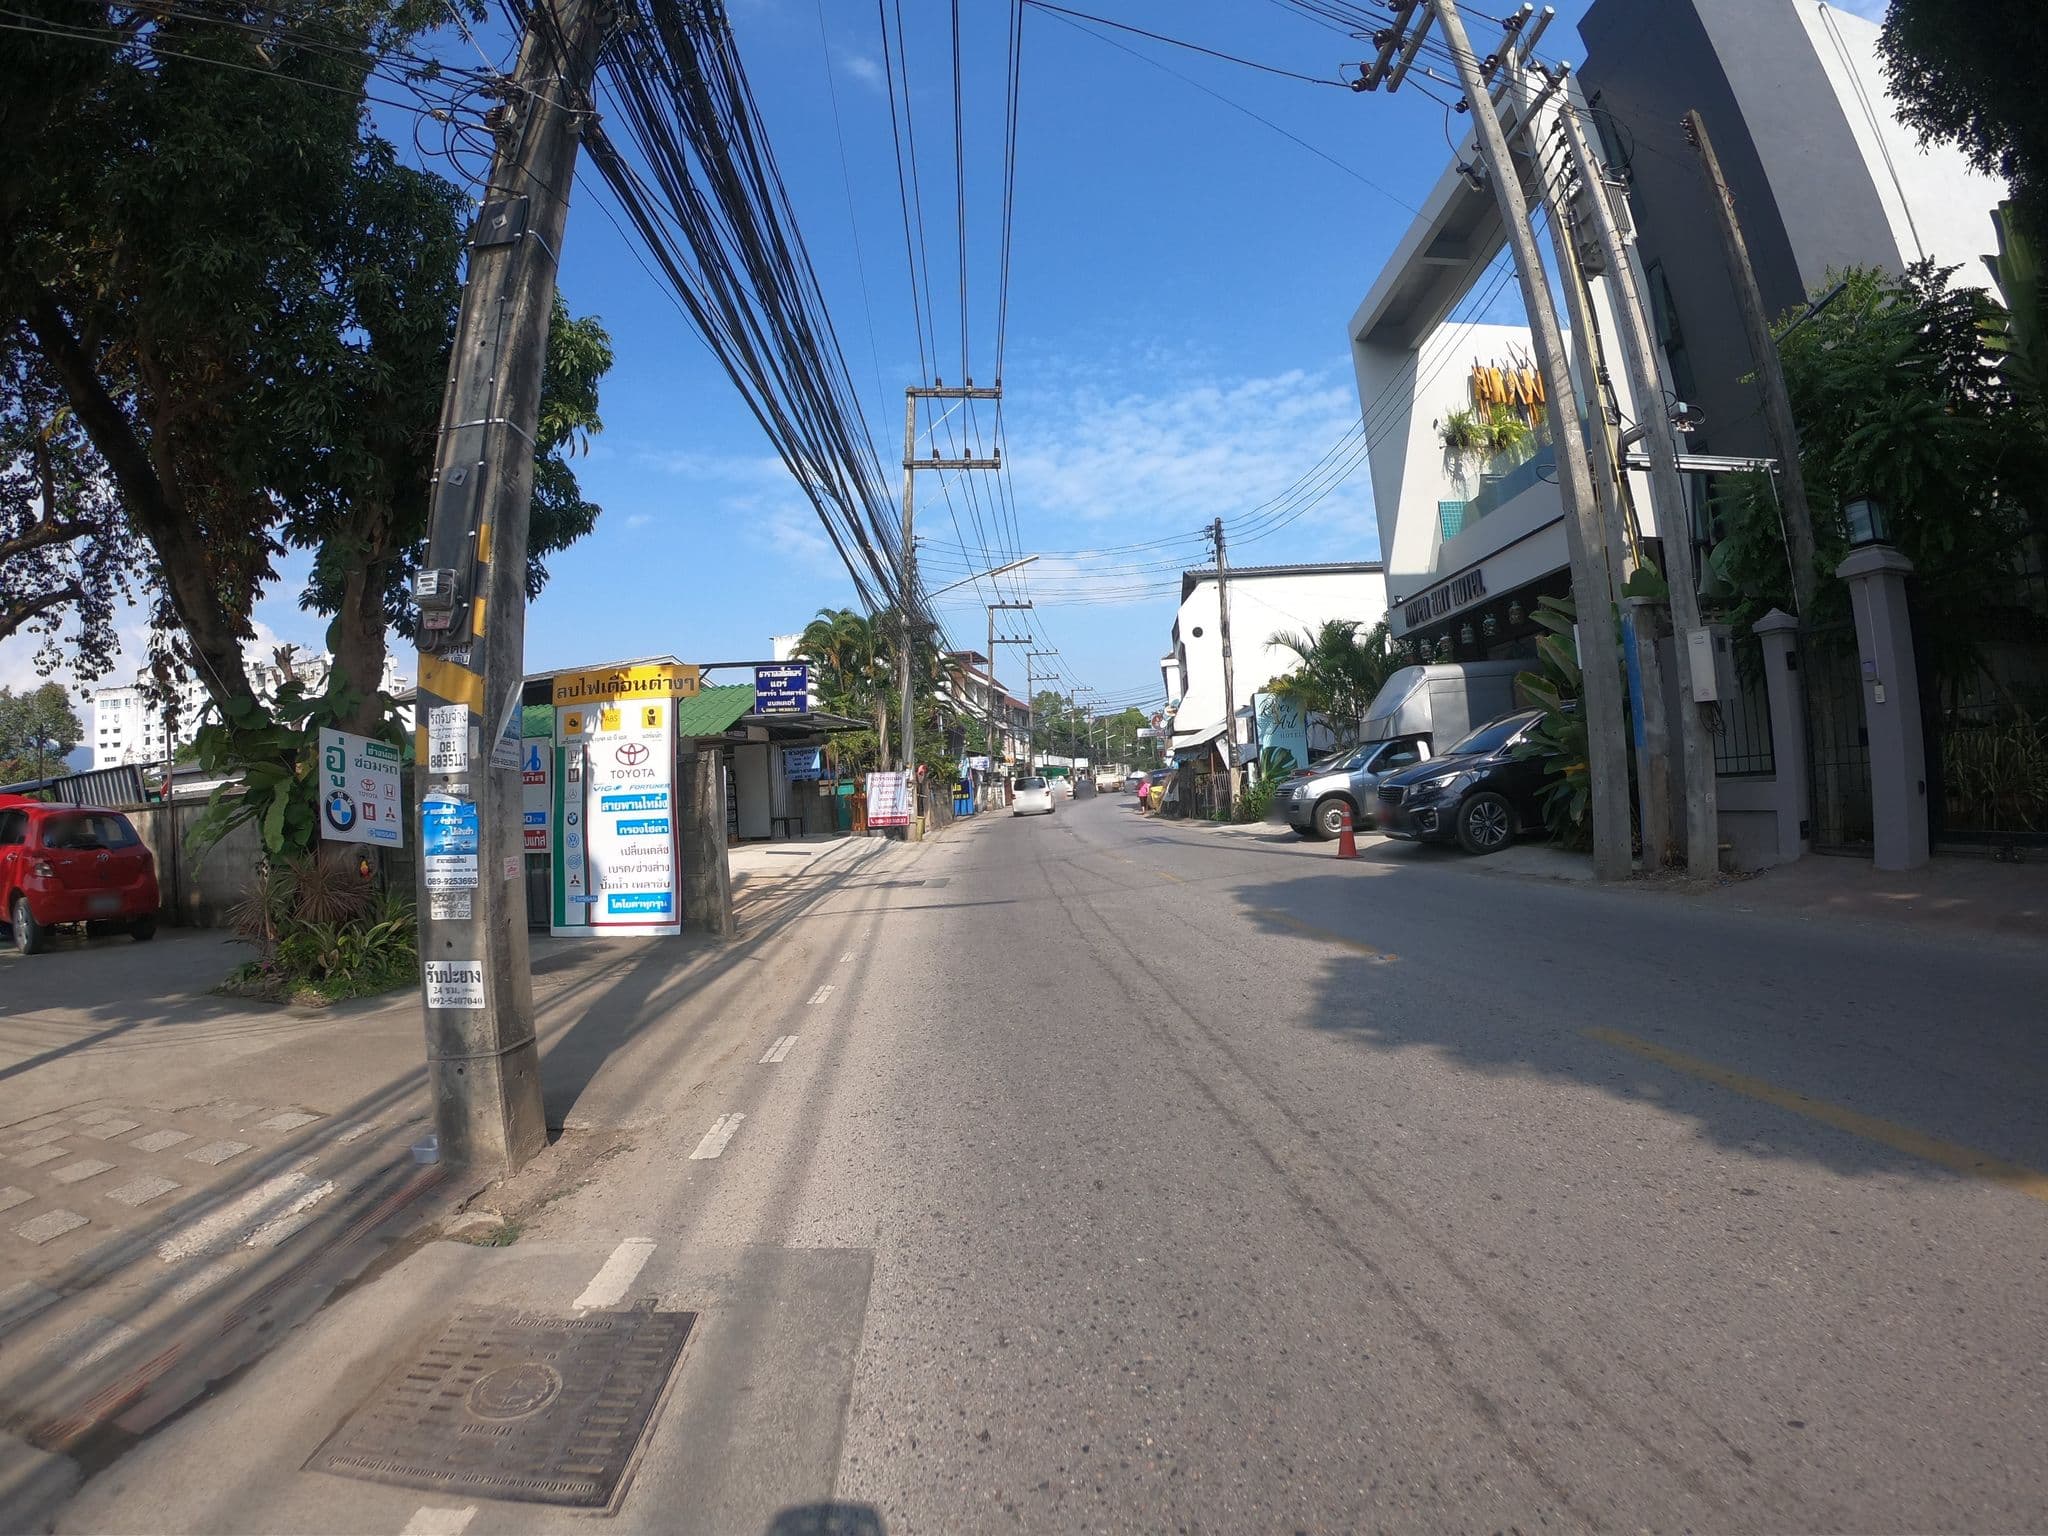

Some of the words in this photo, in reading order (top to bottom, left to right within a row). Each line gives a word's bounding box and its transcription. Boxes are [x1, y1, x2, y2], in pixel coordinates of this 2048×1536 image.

[326, 737, 346, 788] อู่
[610, 768, 656, 780] TOYOTA
[426, 963, 481, 984] รับปะยาง
